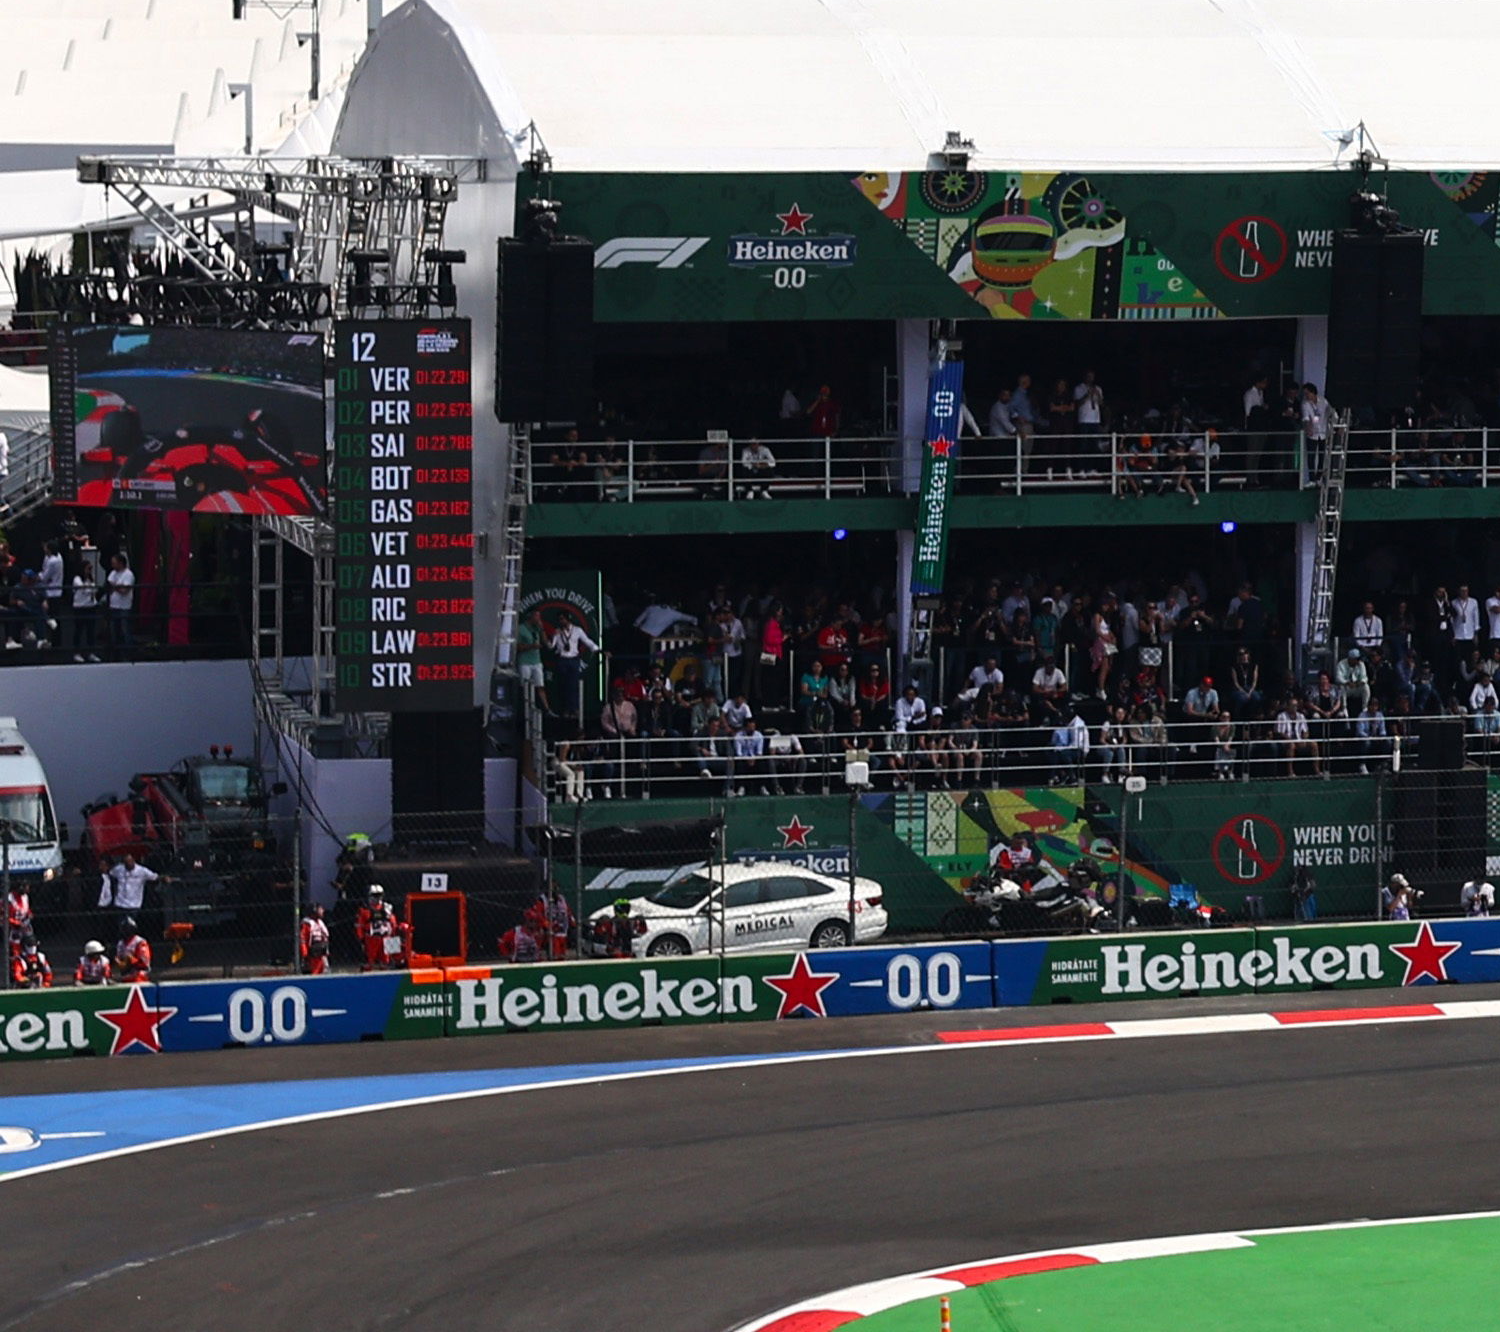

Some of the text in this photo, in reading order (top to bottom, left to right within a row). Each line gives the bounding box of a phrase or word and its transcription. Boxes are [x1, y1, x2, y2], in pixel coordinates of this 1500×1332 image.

[736, 241, 849, 259] Heineken
[775, 268, 805, 288] 0.0
[352, 332, 376, 362] 12
[371, 367, 409, 391] VER
[371, 401, 410, 424] PER
[371, 433, 405, 457] SAI
[371, 466, 412, 490] BOT
[371, 499, 413, 522] GAS
[919, 461, 948, 562] Heineken
[371, 532, 409, 555] VET
[371, 565, 410, 588] ALO
[371, 597, 405, 621] RIC
[372, 630, 415, 653] LAW
[372, 663, 412, 687] STR
[1294, 826, 1342, 844] WHEN
[1294, 848, 1343, 866] NEVER
[426, 877, 441, 889] 13
[734, 916, 794, 936] MEDICAL
[1101, 938, 1384, 993] Heineken
[889, 953, 960, 1007] 0.0
[456, 970, 757, 1028] Heineken
[230, 987, 306, 1042] 0.0
